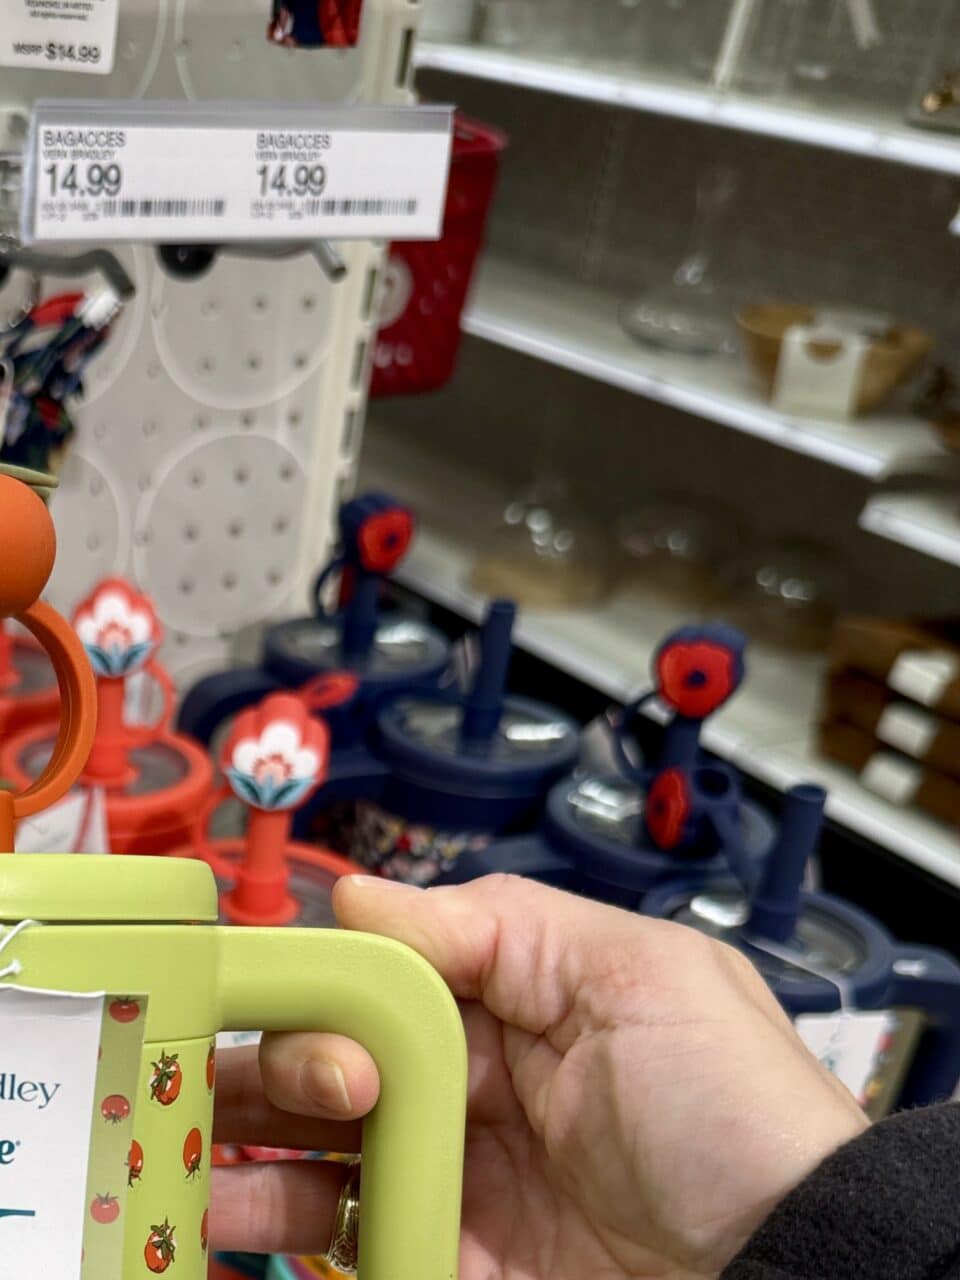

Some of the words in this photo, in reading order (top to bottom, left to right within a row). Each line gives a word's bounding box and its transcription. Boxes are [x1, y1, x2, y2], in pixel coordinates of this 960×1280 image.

[45, 43, 100, 64] $14.99
[43, 131, 127, 147] BAGACCES
[256, 133, 332, 150] BAGACCES
[45, 163, 122, 197] 14.99
[256, 164, 327, 197] 14.99
